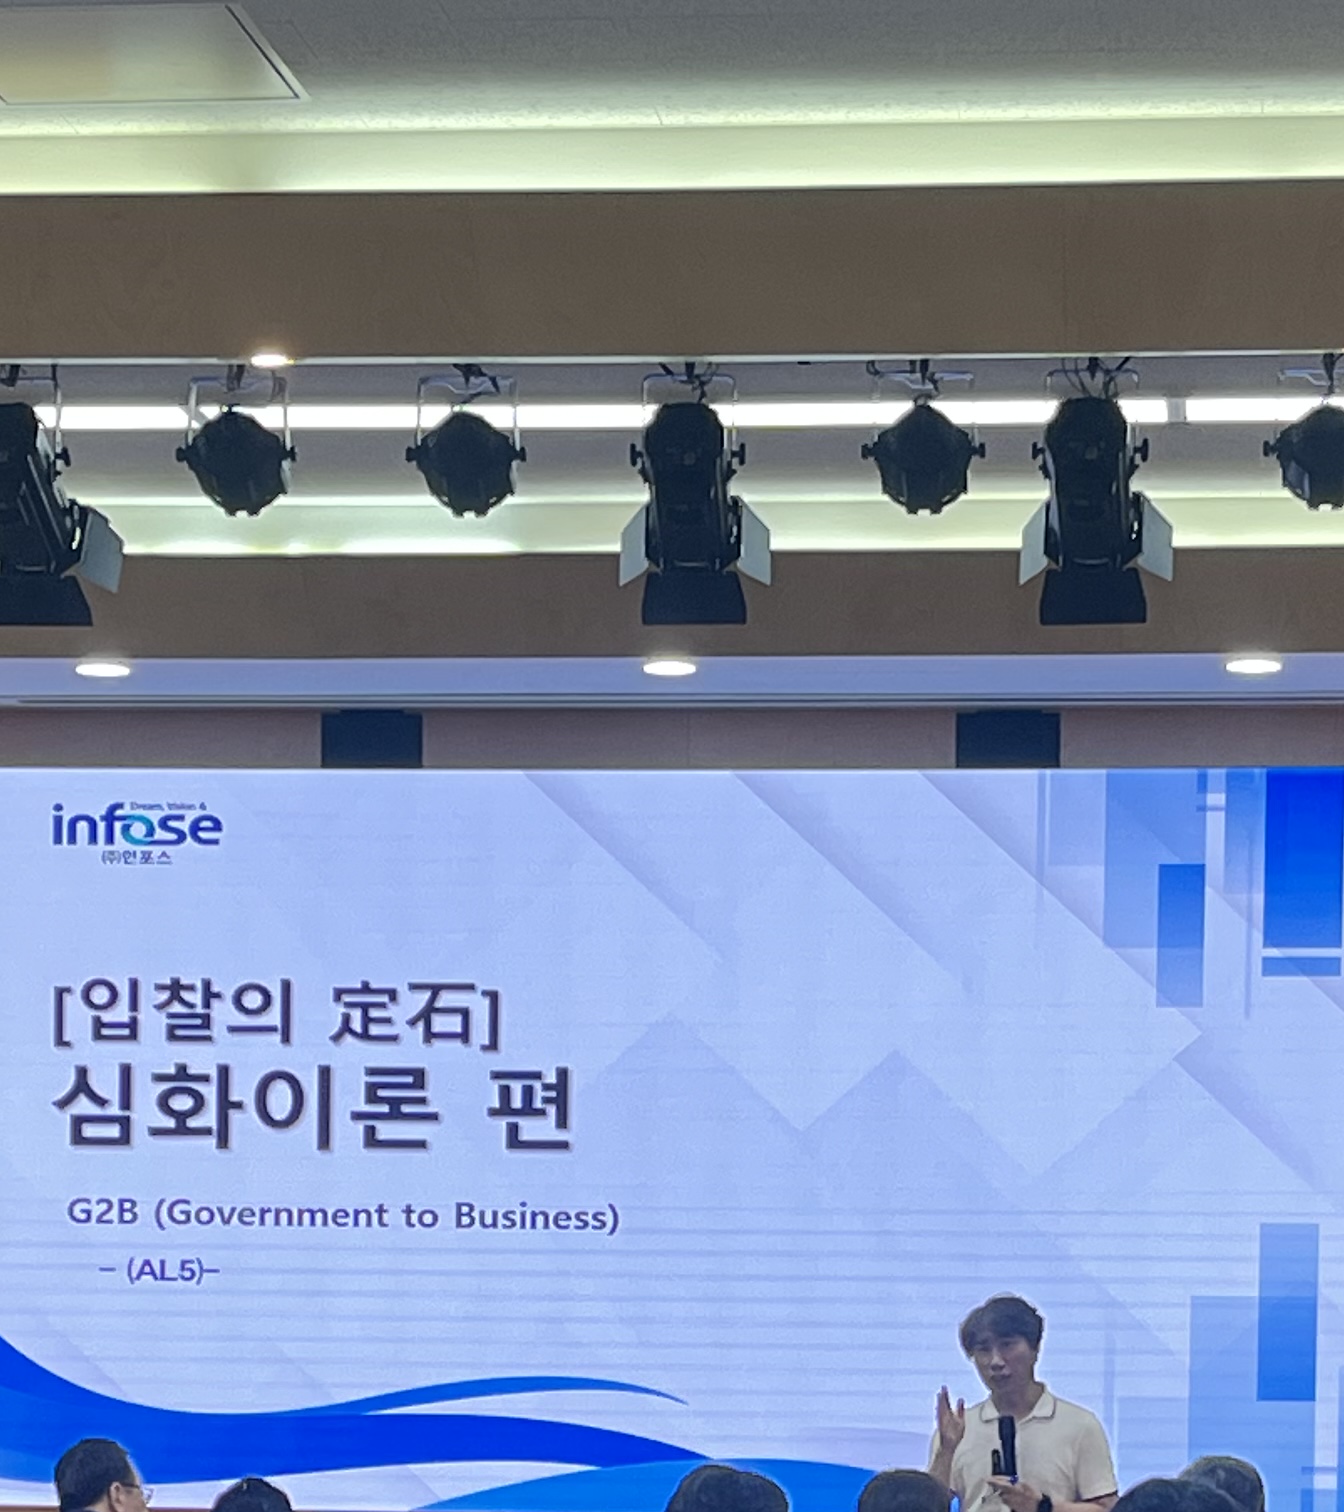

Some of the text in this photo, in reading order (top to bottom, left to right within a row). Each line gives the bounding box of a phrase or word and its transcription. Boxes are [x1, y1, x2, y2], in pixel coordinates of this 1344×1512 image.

[52, 802, 223, 846] infose
[52, 977, 501, 1051] [입찰의 定石]
[52, 1063, 572, 1151] 심화이론 편
[66, 1198, 621, 1236] G2B (Government to Business)
